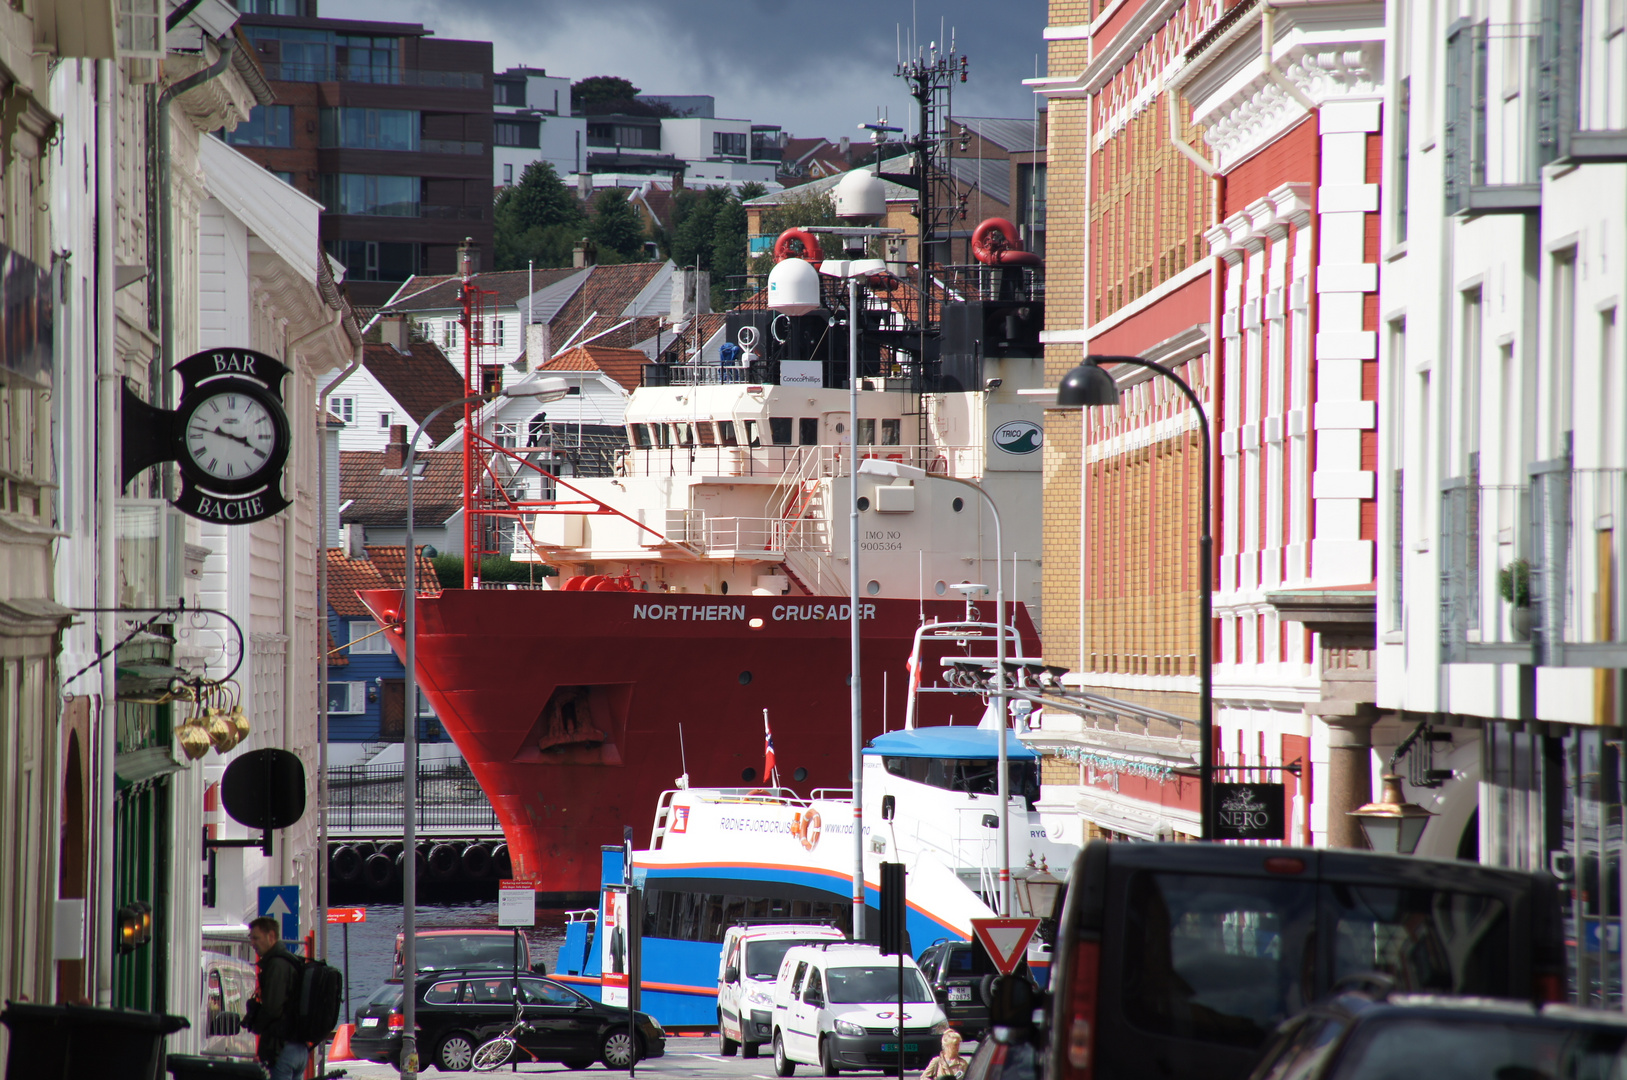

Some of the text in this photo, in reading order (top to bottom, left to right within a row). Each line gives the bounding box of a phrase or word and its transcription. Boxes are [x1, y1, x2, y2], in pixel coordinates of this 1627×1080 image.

[212, 353, 256, 374] BAR
[782, 375, 821, 383] ConocoPhillips
[1001, 429, 1022, 438] TRICO
[196, 496, 264, 520] BACHE
[865, 531, 901, 540] IMO NO
[860, 542, 902, 551] 9005364
[633, 603, 876, 621] NORTHERN CRUSADER
[719, 817, 791, 834] RØDNE FJORDCRUIS
[1218, 811, 1269, 829] NERO
